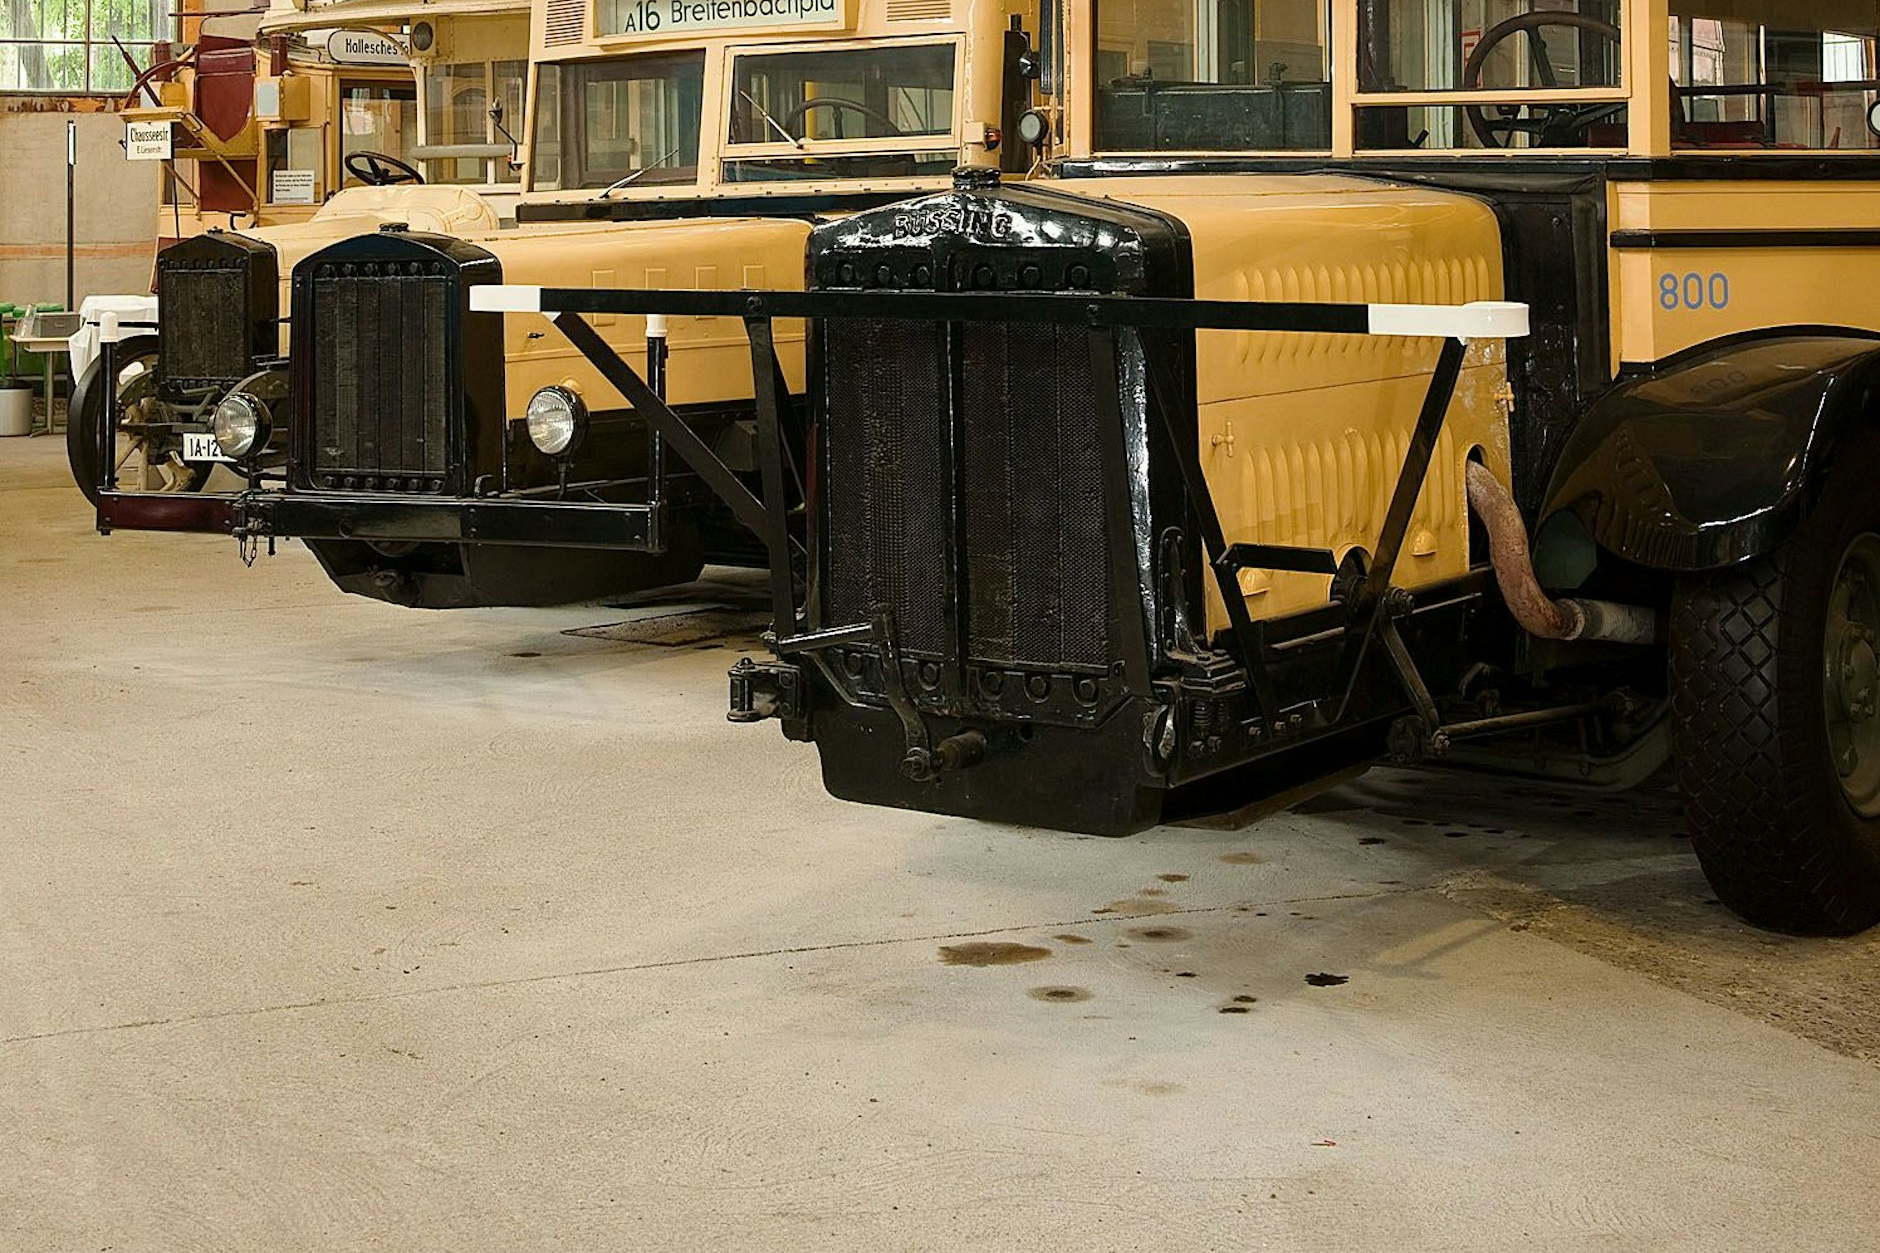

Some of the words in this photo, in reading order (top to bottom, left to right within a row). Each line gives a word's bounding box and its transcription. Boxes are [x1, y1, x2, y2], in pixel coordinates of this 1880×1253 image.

[624, 0, 661, 33] A16
[345, 38, 398, 56] Hallesches
[894, 208, 1015, 238] BÜSSING
[1659, 272, 1729, 310] 800
